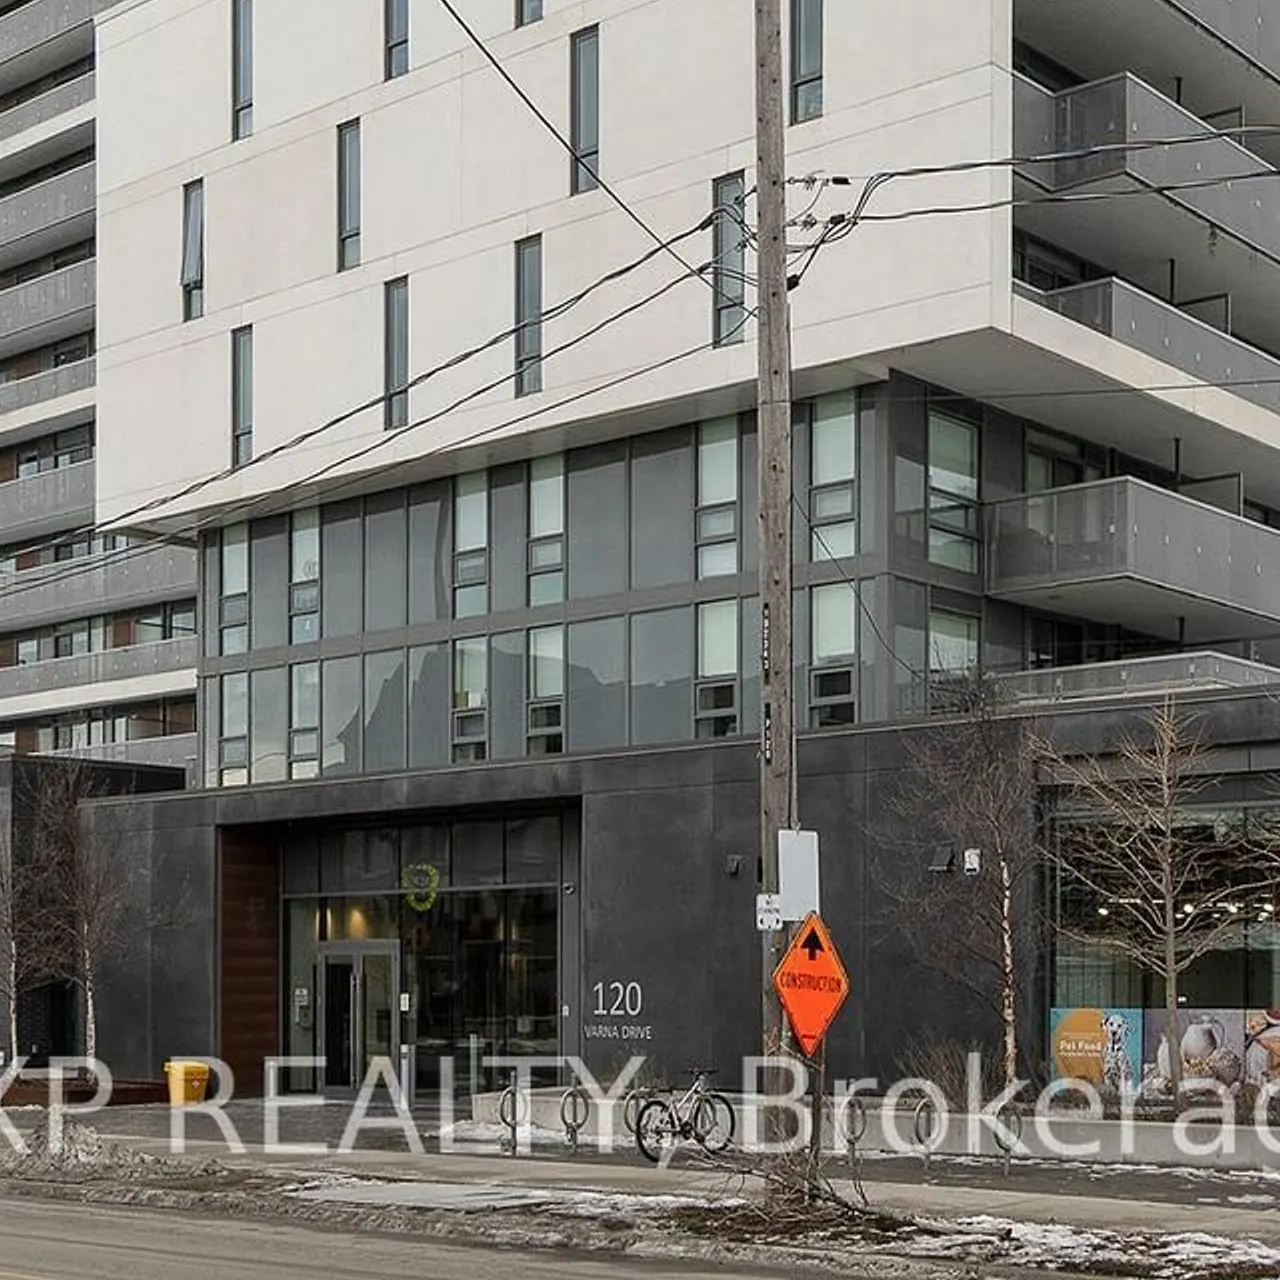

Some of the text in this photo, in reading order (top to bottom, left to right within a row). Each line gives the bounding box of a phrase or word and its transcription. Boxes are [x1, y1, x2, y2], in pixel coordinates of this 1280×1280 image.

[780, 971, 842, 993] CONSTRUCTION
[593, 982, 642, 1015] 120
[584, 1025, 652, 1039] VARNA DRIVE
[1078, 1040, 1101, 1051] Food
